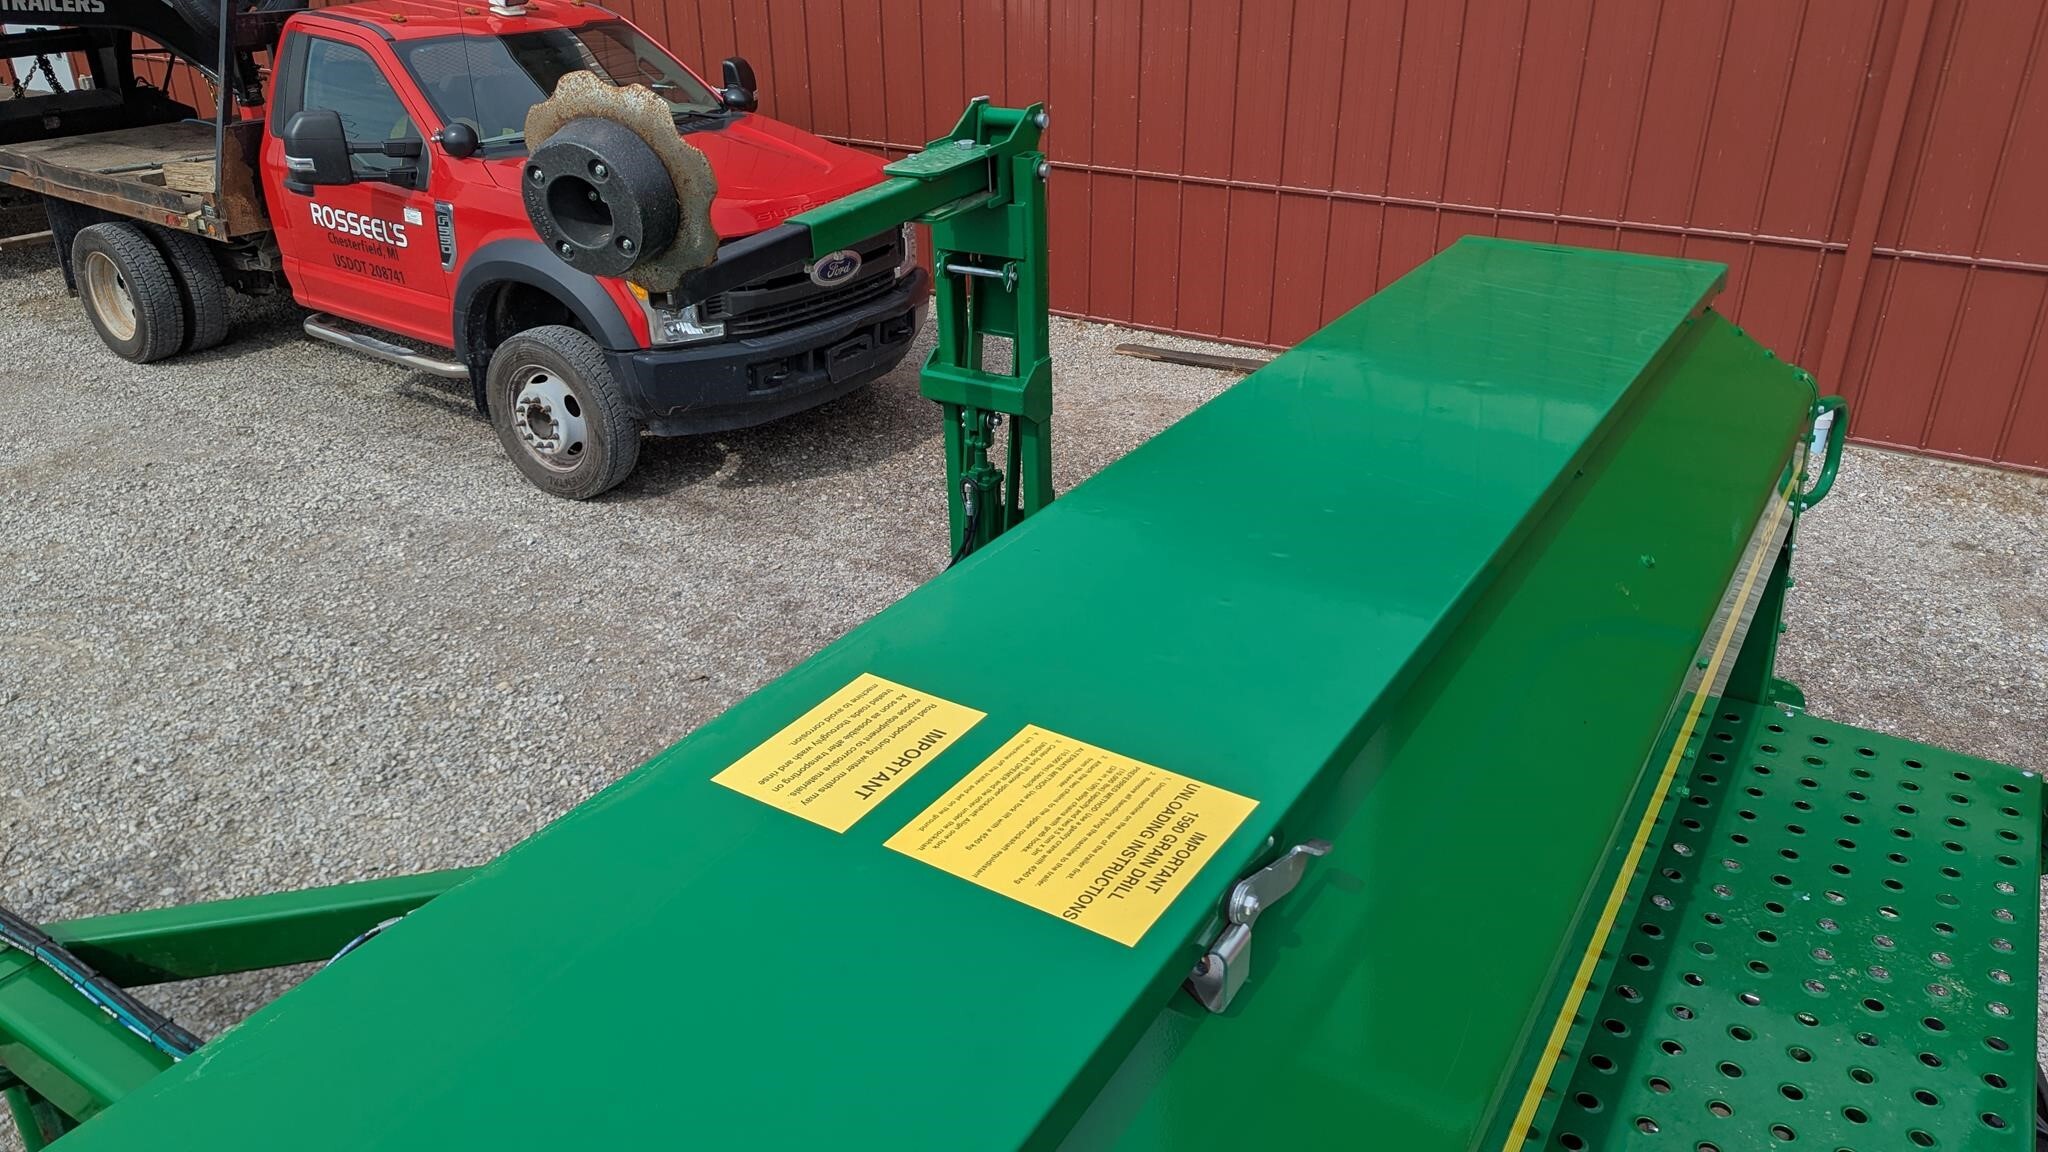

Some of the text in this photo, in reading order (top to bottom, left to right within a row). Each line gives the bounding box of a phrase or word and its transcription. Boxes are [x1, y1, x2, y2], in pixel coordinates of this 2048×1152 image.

[0, 0, 105, 13] TRAILERS
[309, 202, 409, 248] ROSSEEL'S
[327, 232, 400, 261] Chesterfield, MI
[332, 253, 406, 285] USDOT 208741
[827, 259, 851, 278] Ford
[849, 683, 880, 703] machine
[868, 688, 894, 705] treated
[894, 693, 908, 701] As
[878, 700, 897, 712] soon
[894, 697, 921, 715] expose
[822, 708, 846, 722] avoid
[809, 718, 851, 746] thoroughly
[840, 718, 874, 740] possible
[860, 714, 900, 741] equipment
[791, 745, 815, 760] wash
[826, 739, 846, 752] after
[1003, 743, 1025, 759] machine
[1027, 741, 1048, 756] UNDER
[1037, 744, 1056, 757] Center
[798, 703, 937, 805] Road transport during winter months may
[822, 746, 859, 771] corrosive
[1028, 757, 1041, 766] fork
[1055, 747, 1084, 770] ALTERNATE
[776, 759, 795, 771] and
[780, 750, 830, 784] transporting
[850, 728, 947, 800] IMPORTANT
[1041, 762, 1054, 771] lbs)
[1079, 757, 1093, 767] from
[1084, 760, 1102, 774] Attach
[757, 770, 780, 785] rinse
[972, 772, 990, 785] trailer
[998, 762, 1023, 780] OPENER
[1006, 771, 1024, 784] below
[1110, 766, 1140, 792] PREFERRED
[1129, 776, 1150, 793] Remove
[770, 783, 784, 791] on
[991, 782, 1009, 796] upper
[1096, 782, 1111, 792] lbs)
[1147, 782, 1166, 797] Unload
[966, 795, 984, 808] other
[1052, 788, 1072, 803] chains
[1073, 790, 1090, 801] alloy
[1078, 790, 1102, 809] capacity
[1008, 802, 1022, 811] fork
[1059, 801, 1079, 816] chains
[1103, 798, 1127, 817] banding
[1129, 797, 1151, 815] machine
[950, 807, 970, 821] under
[1022, 814, 1041, 828] upper
[1048, 815, 1063, 826] with
[951, 816, 970, 830] Align
[989, 818, 1004, 828] with
[1091, 816, 1109, 829] tying
[972, 831, 989, 843] 4540
[1035, 825, 1052, 837] grab
[1057, 824, 1079, 841] gantry
[1105, 829, 1117, 839] rear
[930, 838, 945, 849] fork
[1000, 828, 1027, 850] rockshaft
[1064, 836, 1089, 857] machine
[1044, 840, 1062, 854] crane
[1060, 782, 1201, 921] UNLOADING INSTRUCTIONS
[969, 850, 1003, 877] equidistant
[1033, 854, 1049, 865] with
[1076, 853, 1095, 868] trailer
[1106, 810, 1200, 902] 1590 GRAIN DRILL
[1142, 831, 1207, 894] IMPORTANT
[1021, 864, 1038, 877] 4540
